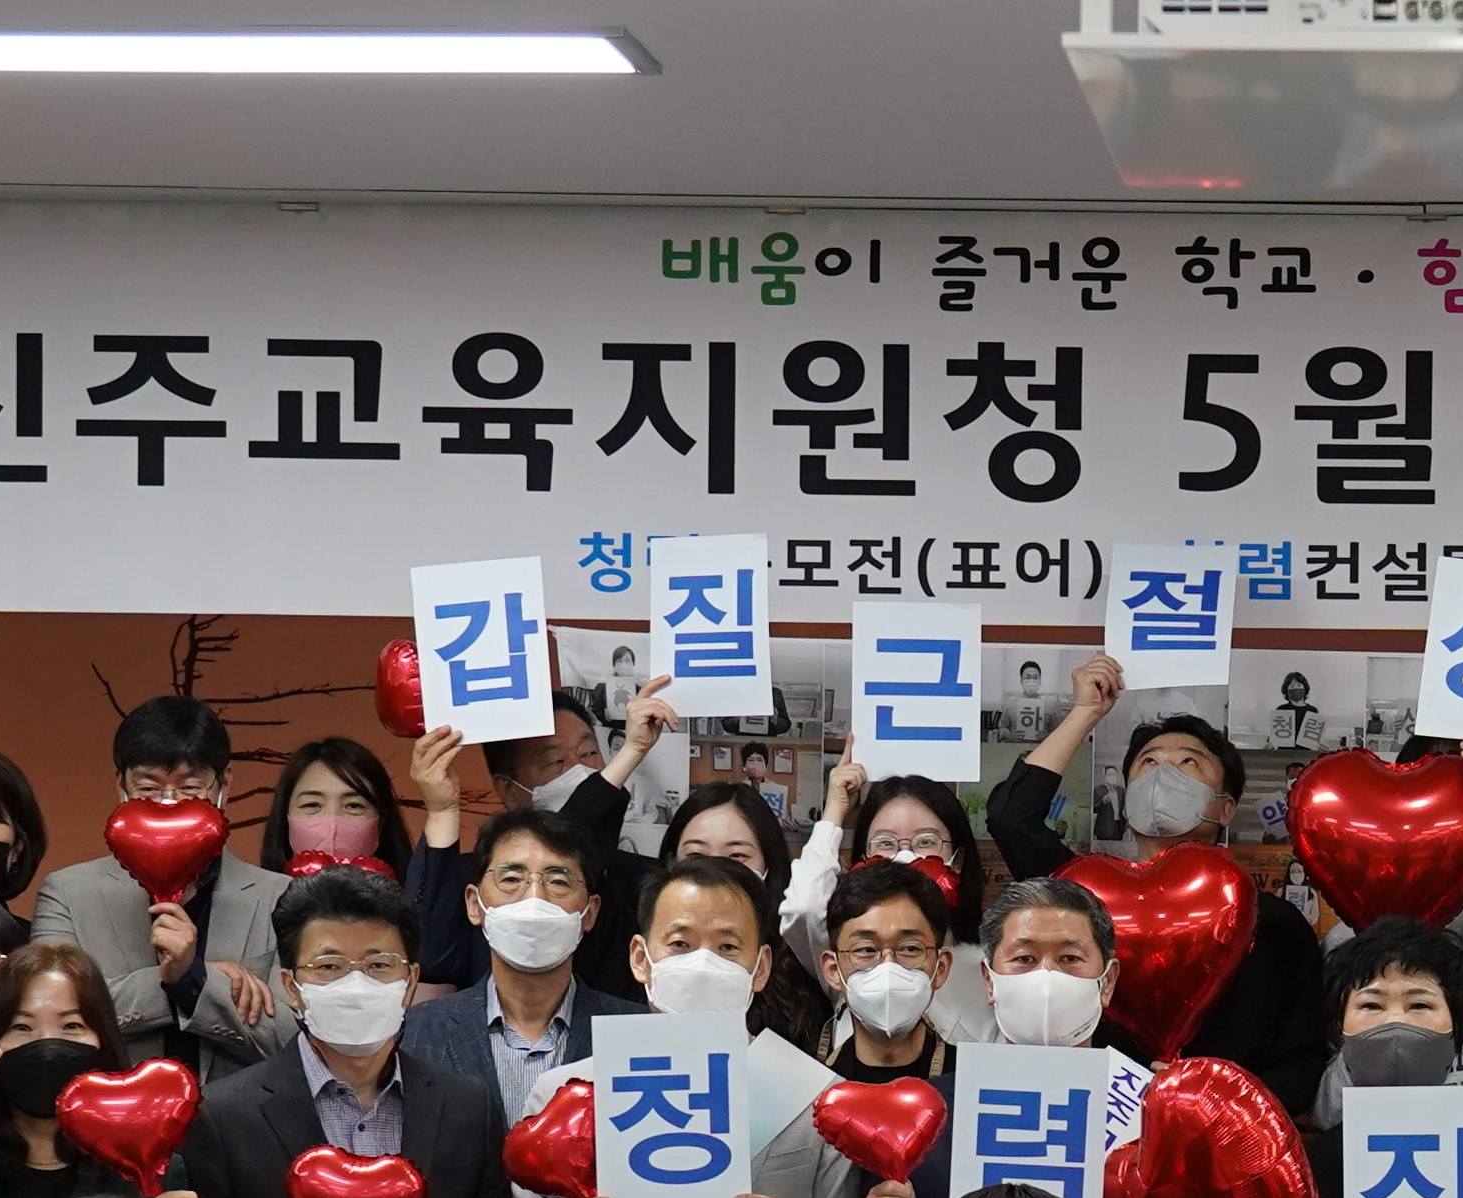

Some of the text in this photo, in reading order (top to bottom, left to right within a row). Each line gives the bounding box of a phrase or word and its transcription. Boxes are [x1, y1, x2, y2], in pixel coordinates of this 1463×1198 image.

[661, 231, 882, 306] 배움이
[931, 235, 1127, 311] 즐거운
[1175, 236, 1317, 310] 학교
[1178, 347, 1436, 505] 5월
[578, 532, 1104, 600] 청모전(표어)
[1122, 568, 1223, 652] 절
[433, 592, 539, 707] 갑
[664, 568, 758, 679] 질
[864, 638, 973, 741] 근
[610, 1053, 732, 1185] 청
